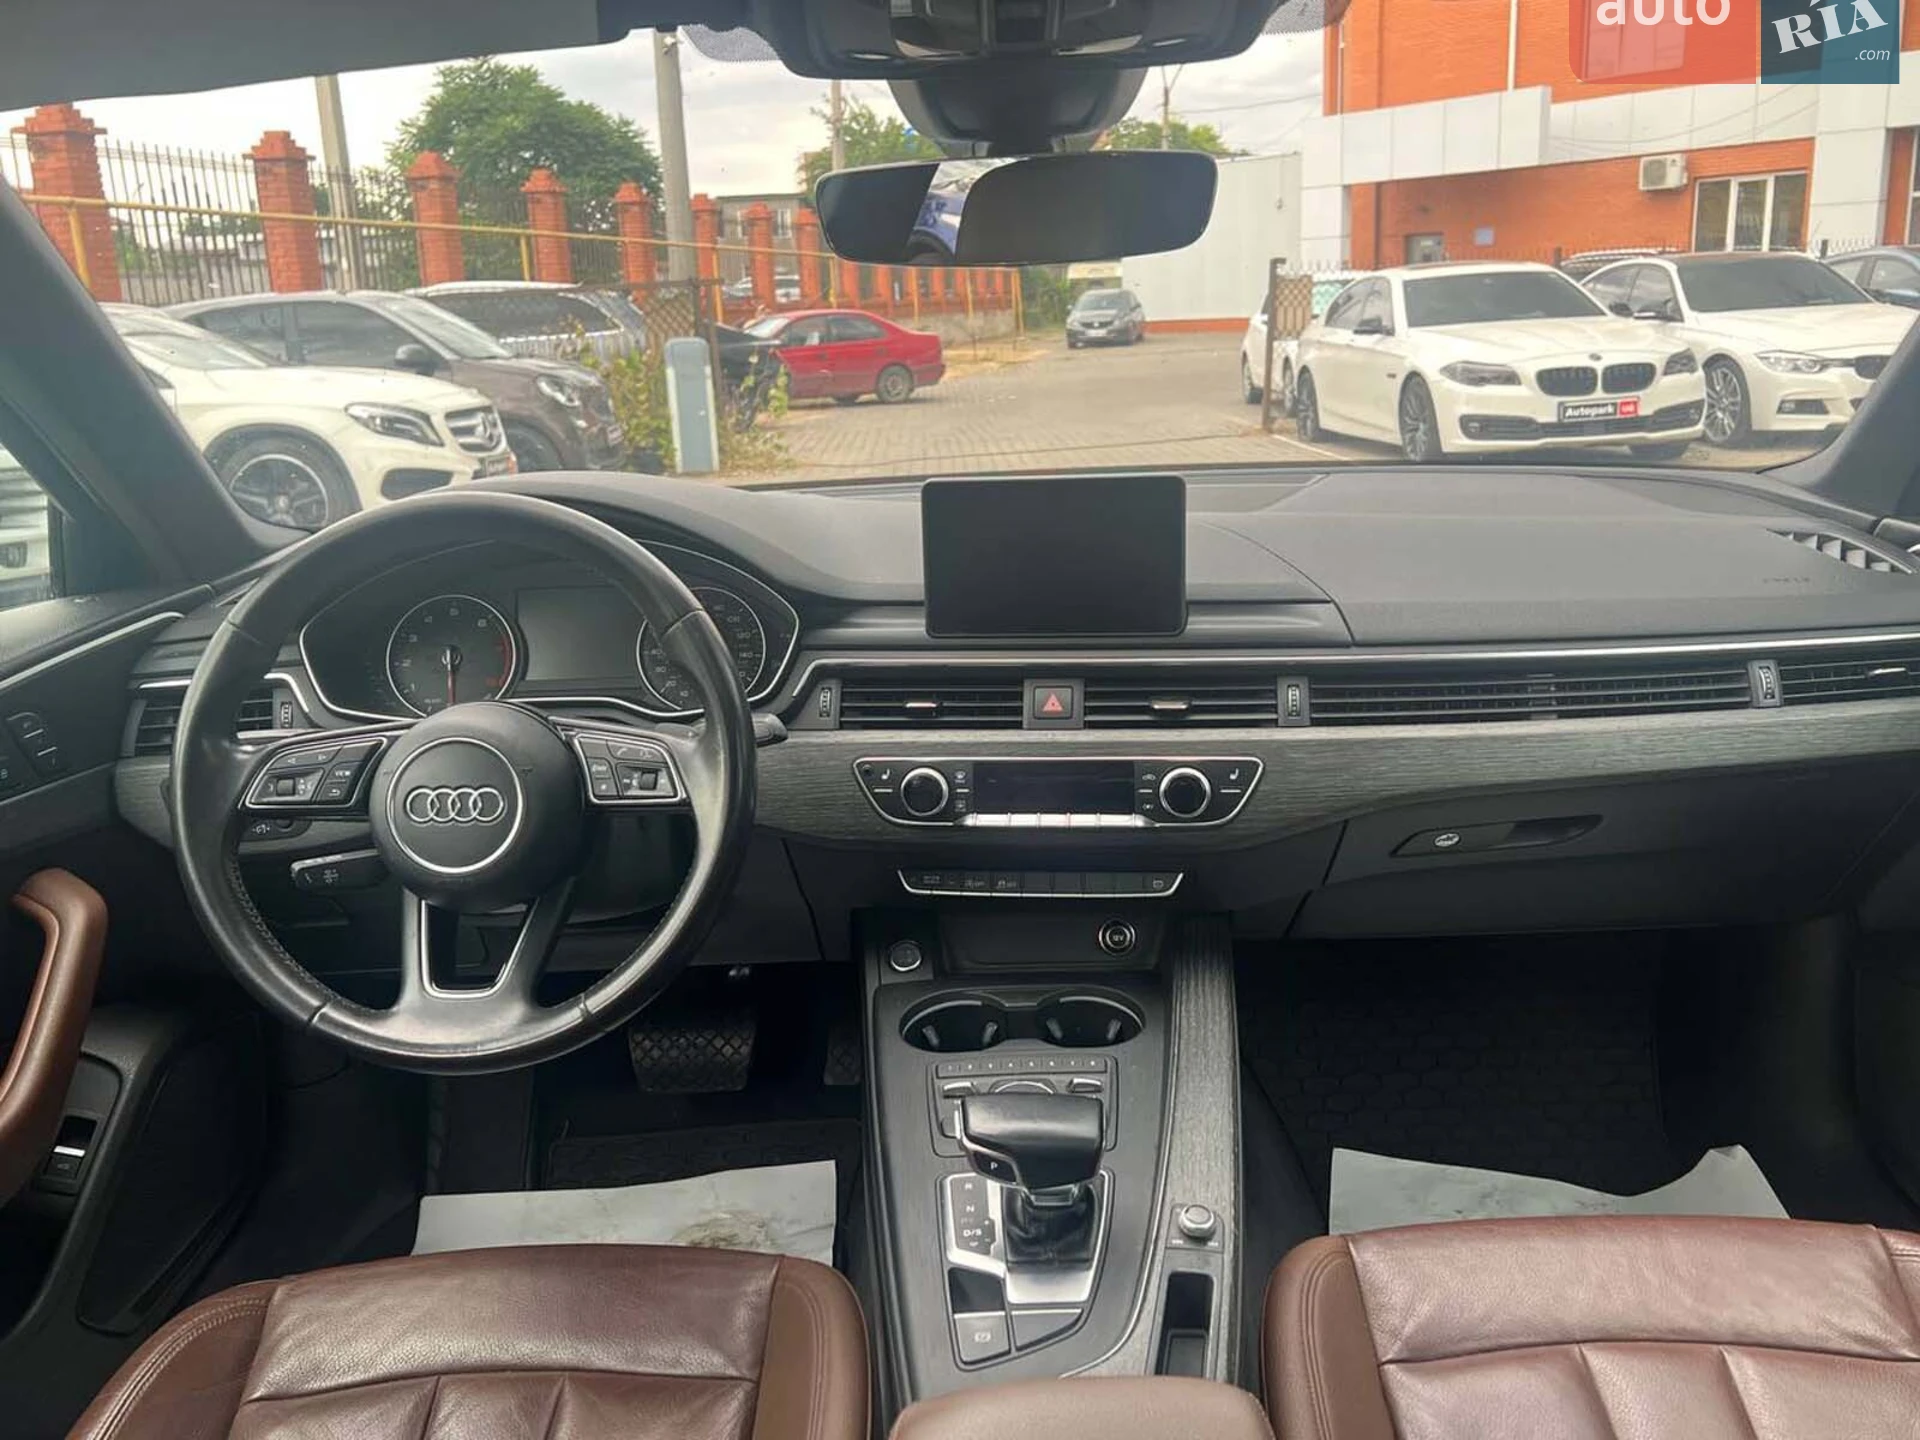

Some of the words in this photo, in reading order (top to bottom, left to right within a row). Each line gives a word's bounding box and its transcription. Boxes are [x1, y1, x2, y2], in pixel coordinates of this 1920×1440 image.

[1565, 403, 1614, 417] Autopark
[990, 1161, 998, 1170] P
[966, 1204, 976, 1213] N
